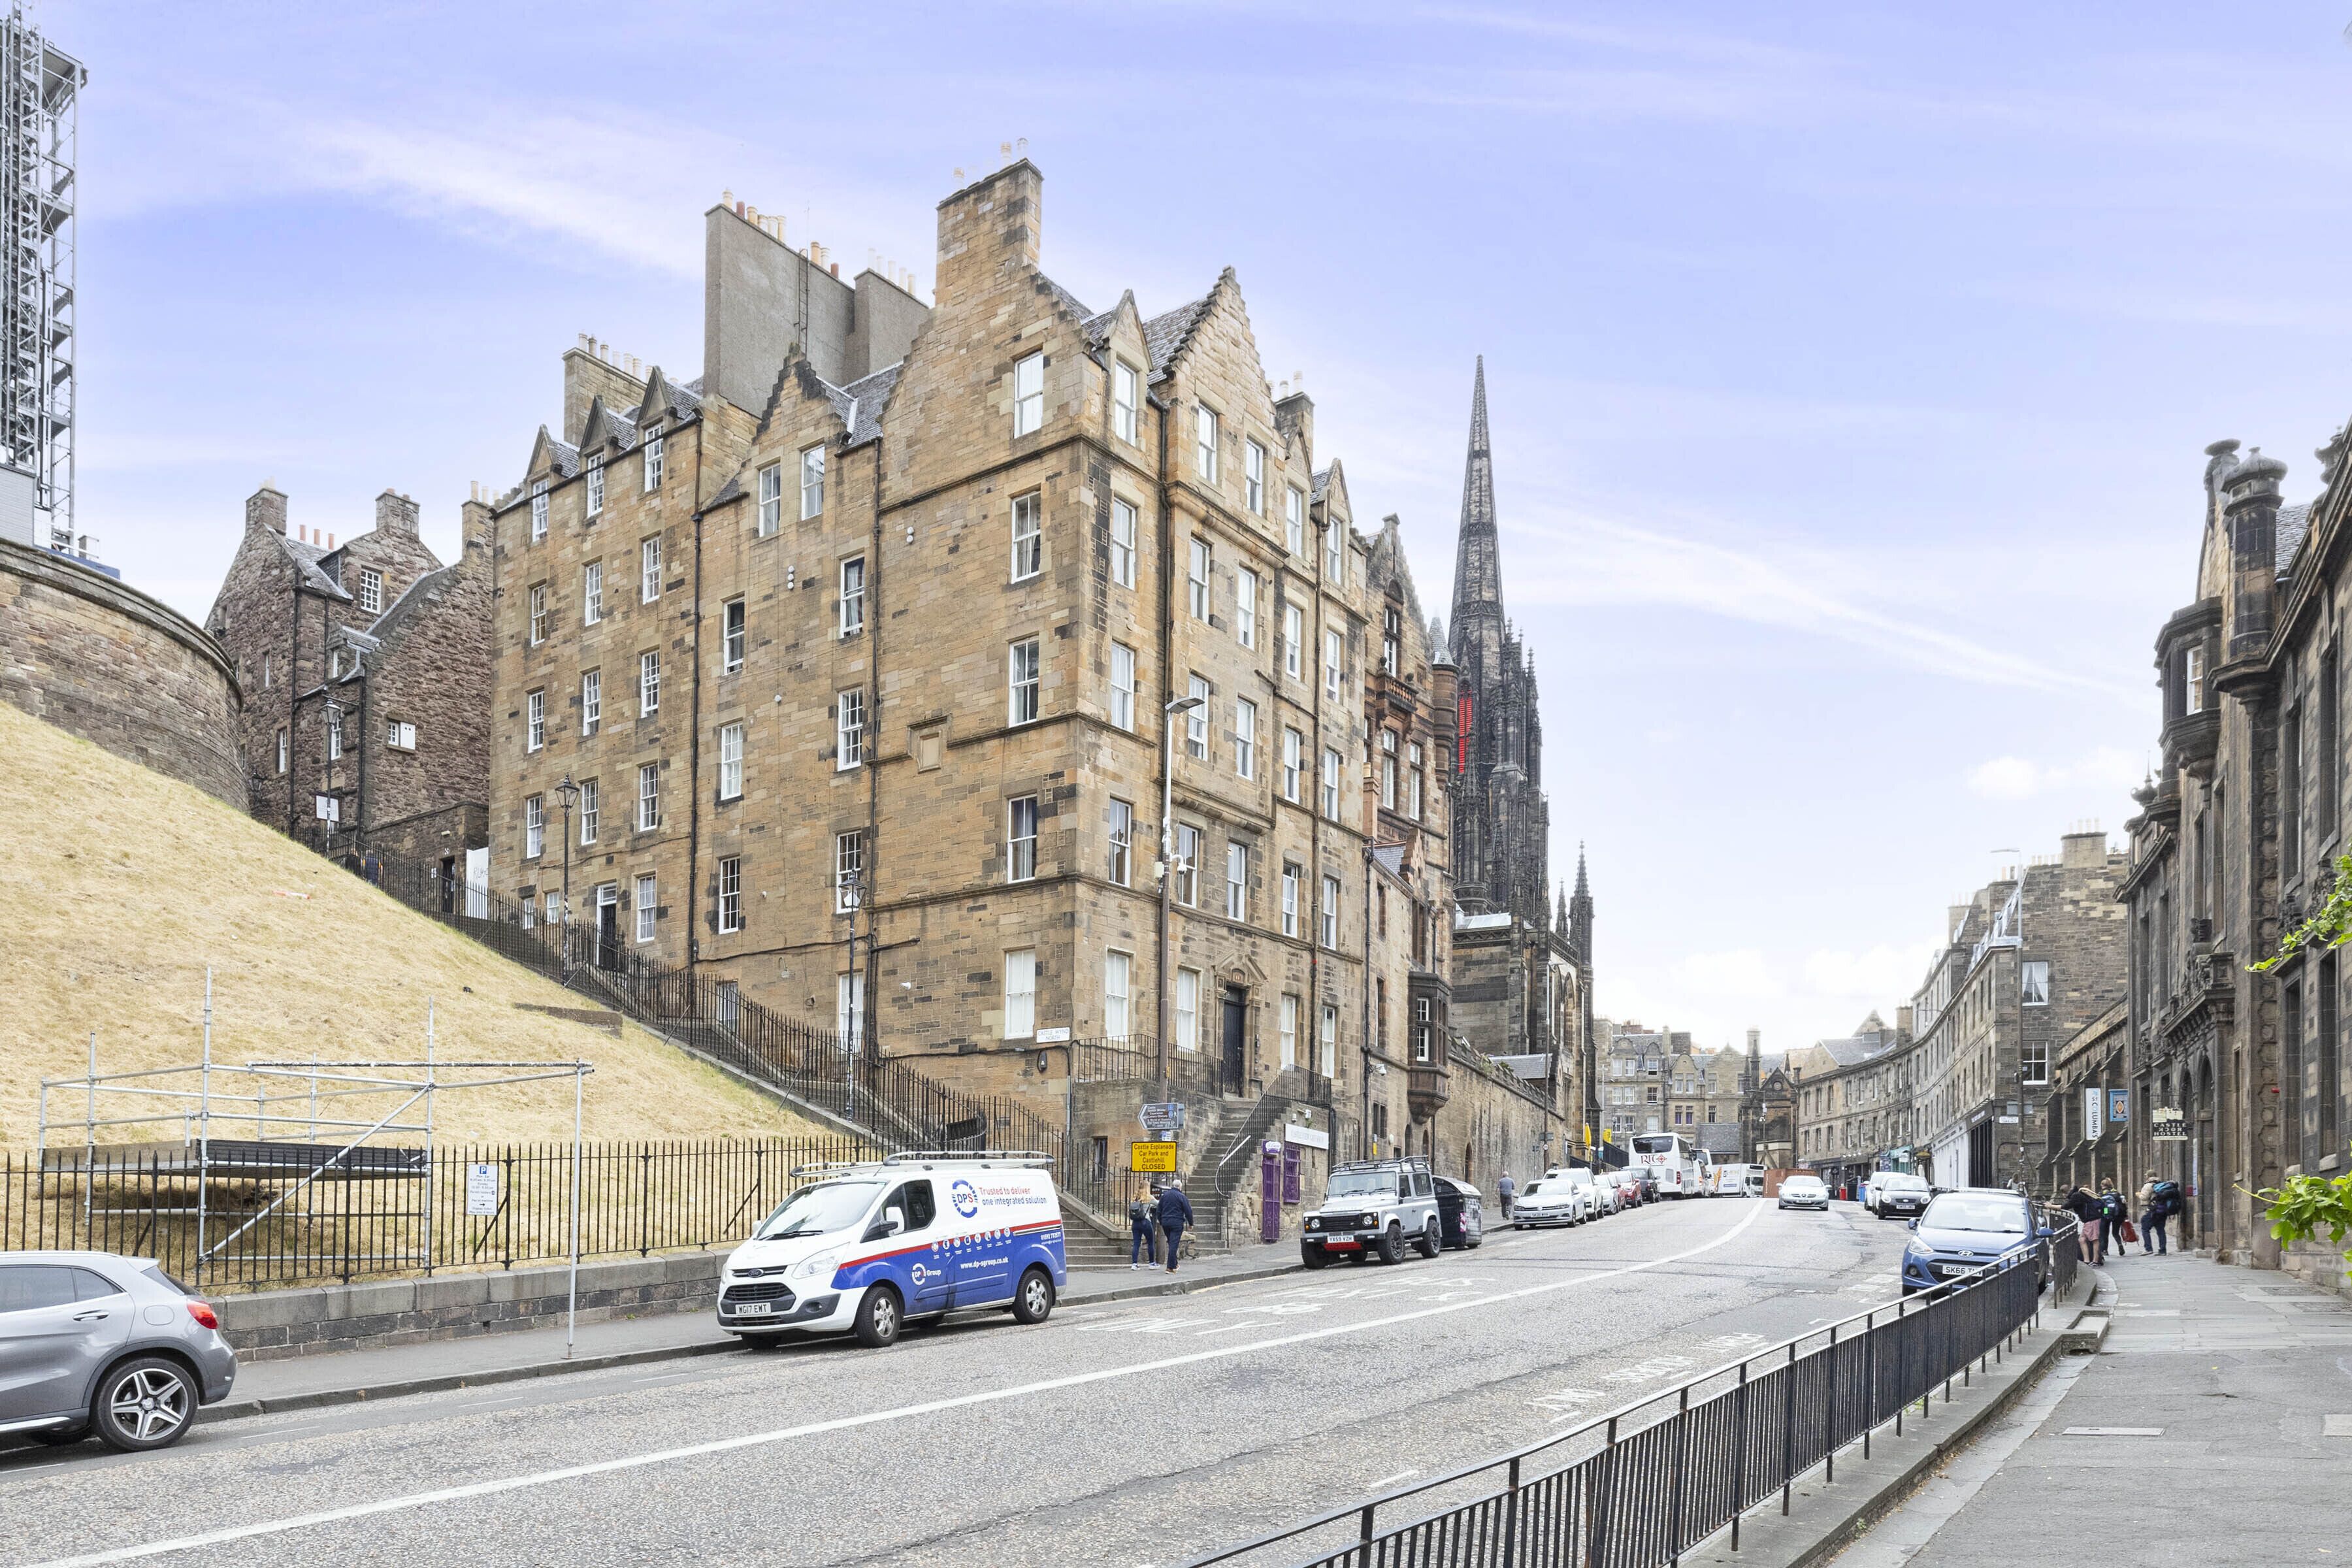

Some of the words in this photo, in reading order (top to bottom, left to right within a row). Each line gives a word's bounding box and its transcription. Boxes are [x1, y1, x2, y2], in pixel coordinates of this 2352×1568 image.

[979, 1187, 1004, 1196] Trusted
[1010, 1186, 1031, 1195] deliver
[956, 1193, 973, 1203] DPS
[994, 1197, 1024, 1207] integrated
[960, 1256, 1009, 1269] www.dp-sgroup.co.uk
[1076, 1318, 1285, 1335] ONLY
